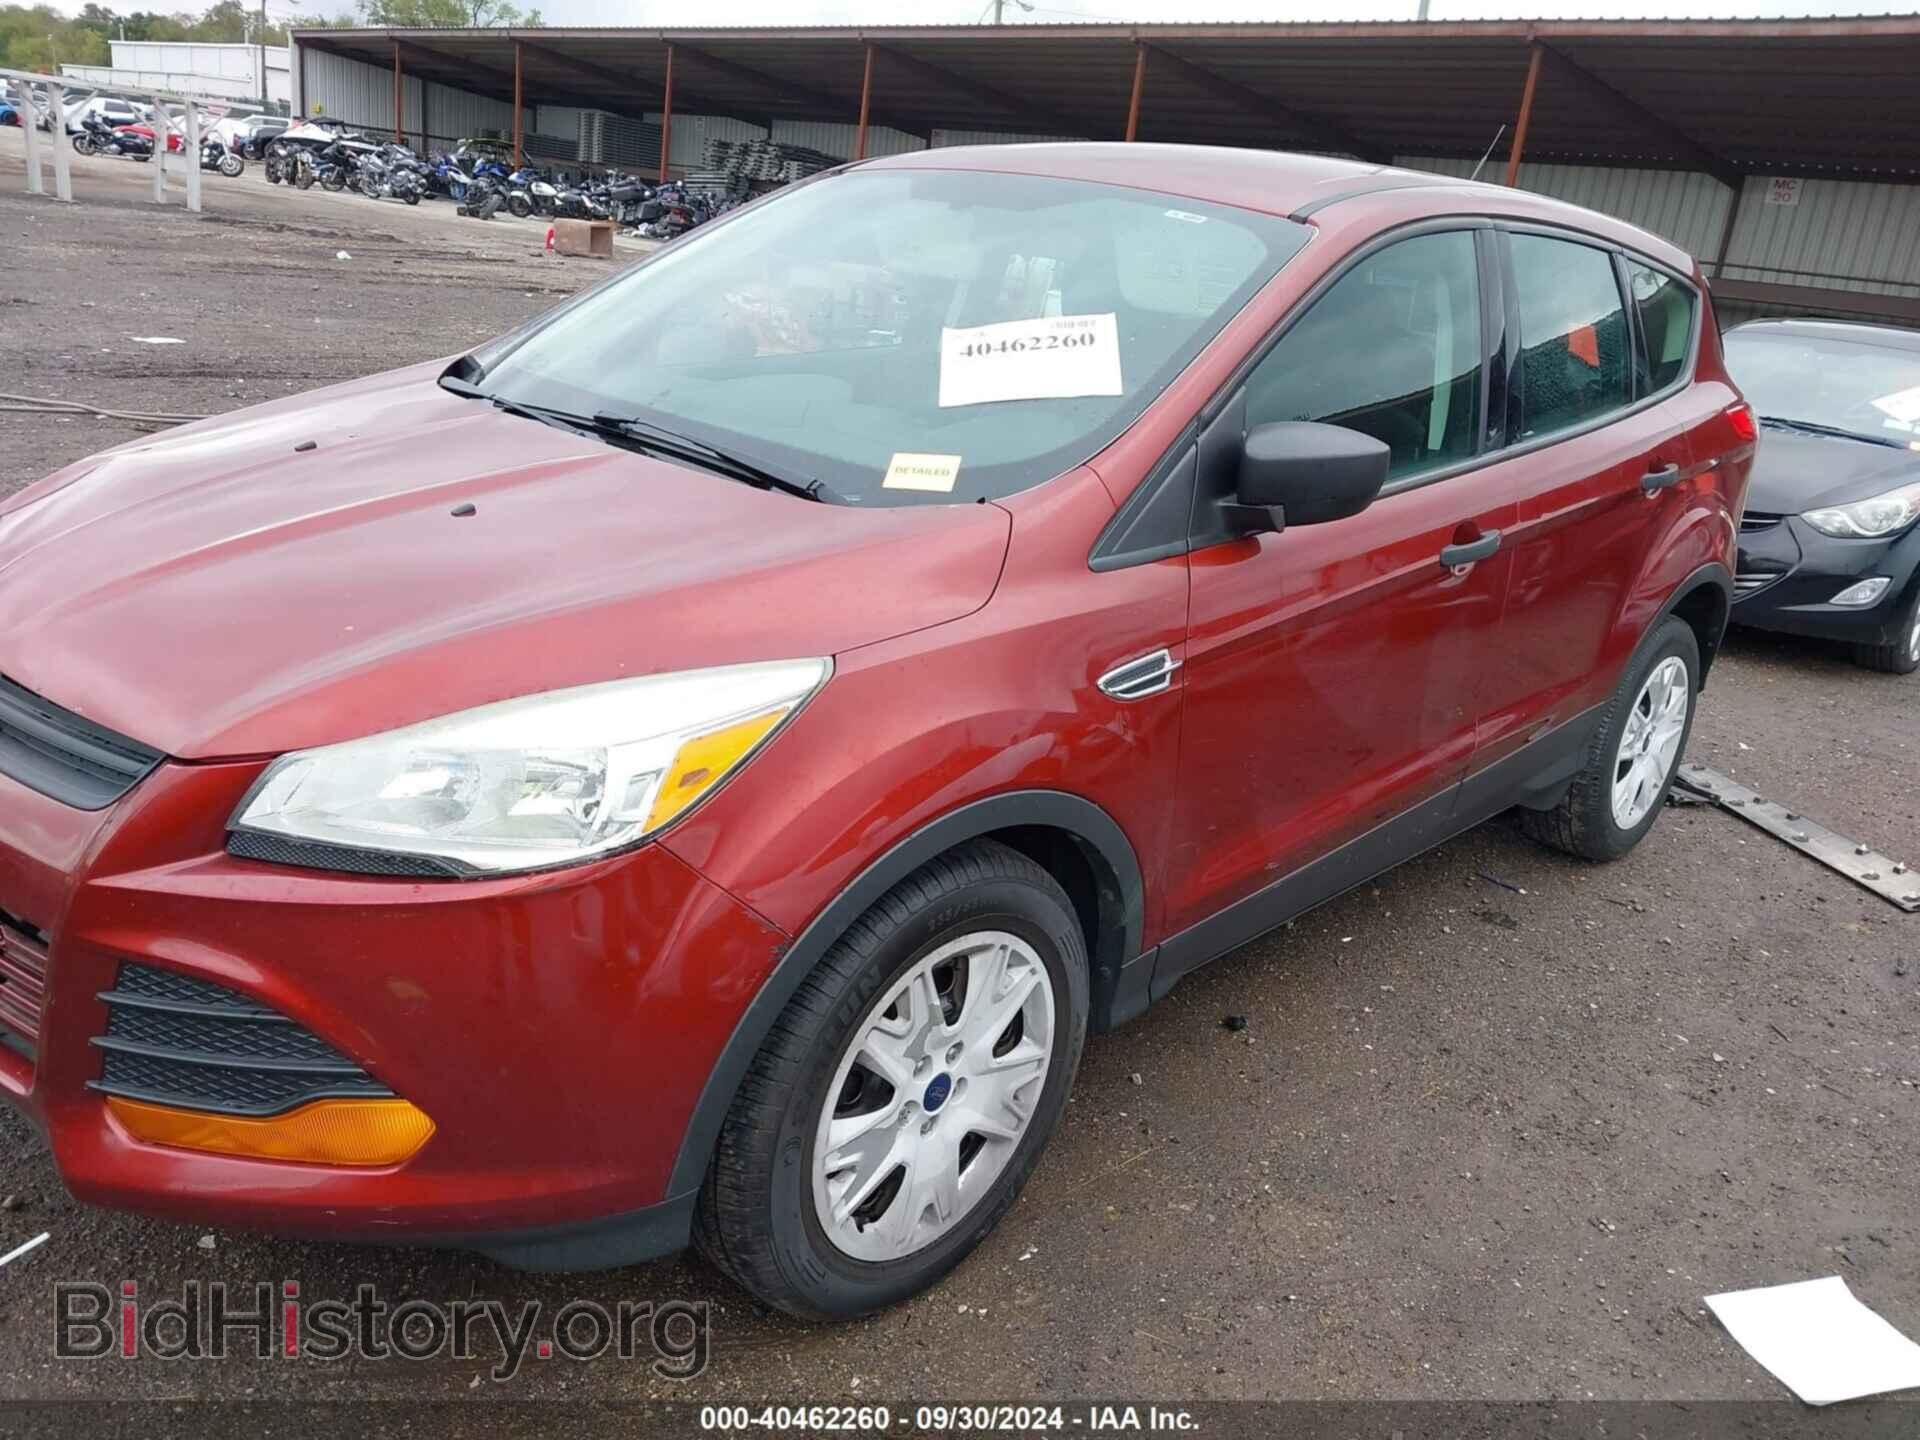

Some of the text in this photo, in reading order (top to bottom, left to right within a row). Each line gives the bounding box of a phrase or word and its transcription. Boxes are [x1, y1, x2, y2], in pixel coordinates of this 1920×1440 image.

[1774, 179, 1797, 191] MC
[959, 332, 1096, 358] 40462260
[894, 465, 951, 477] DETAILED
